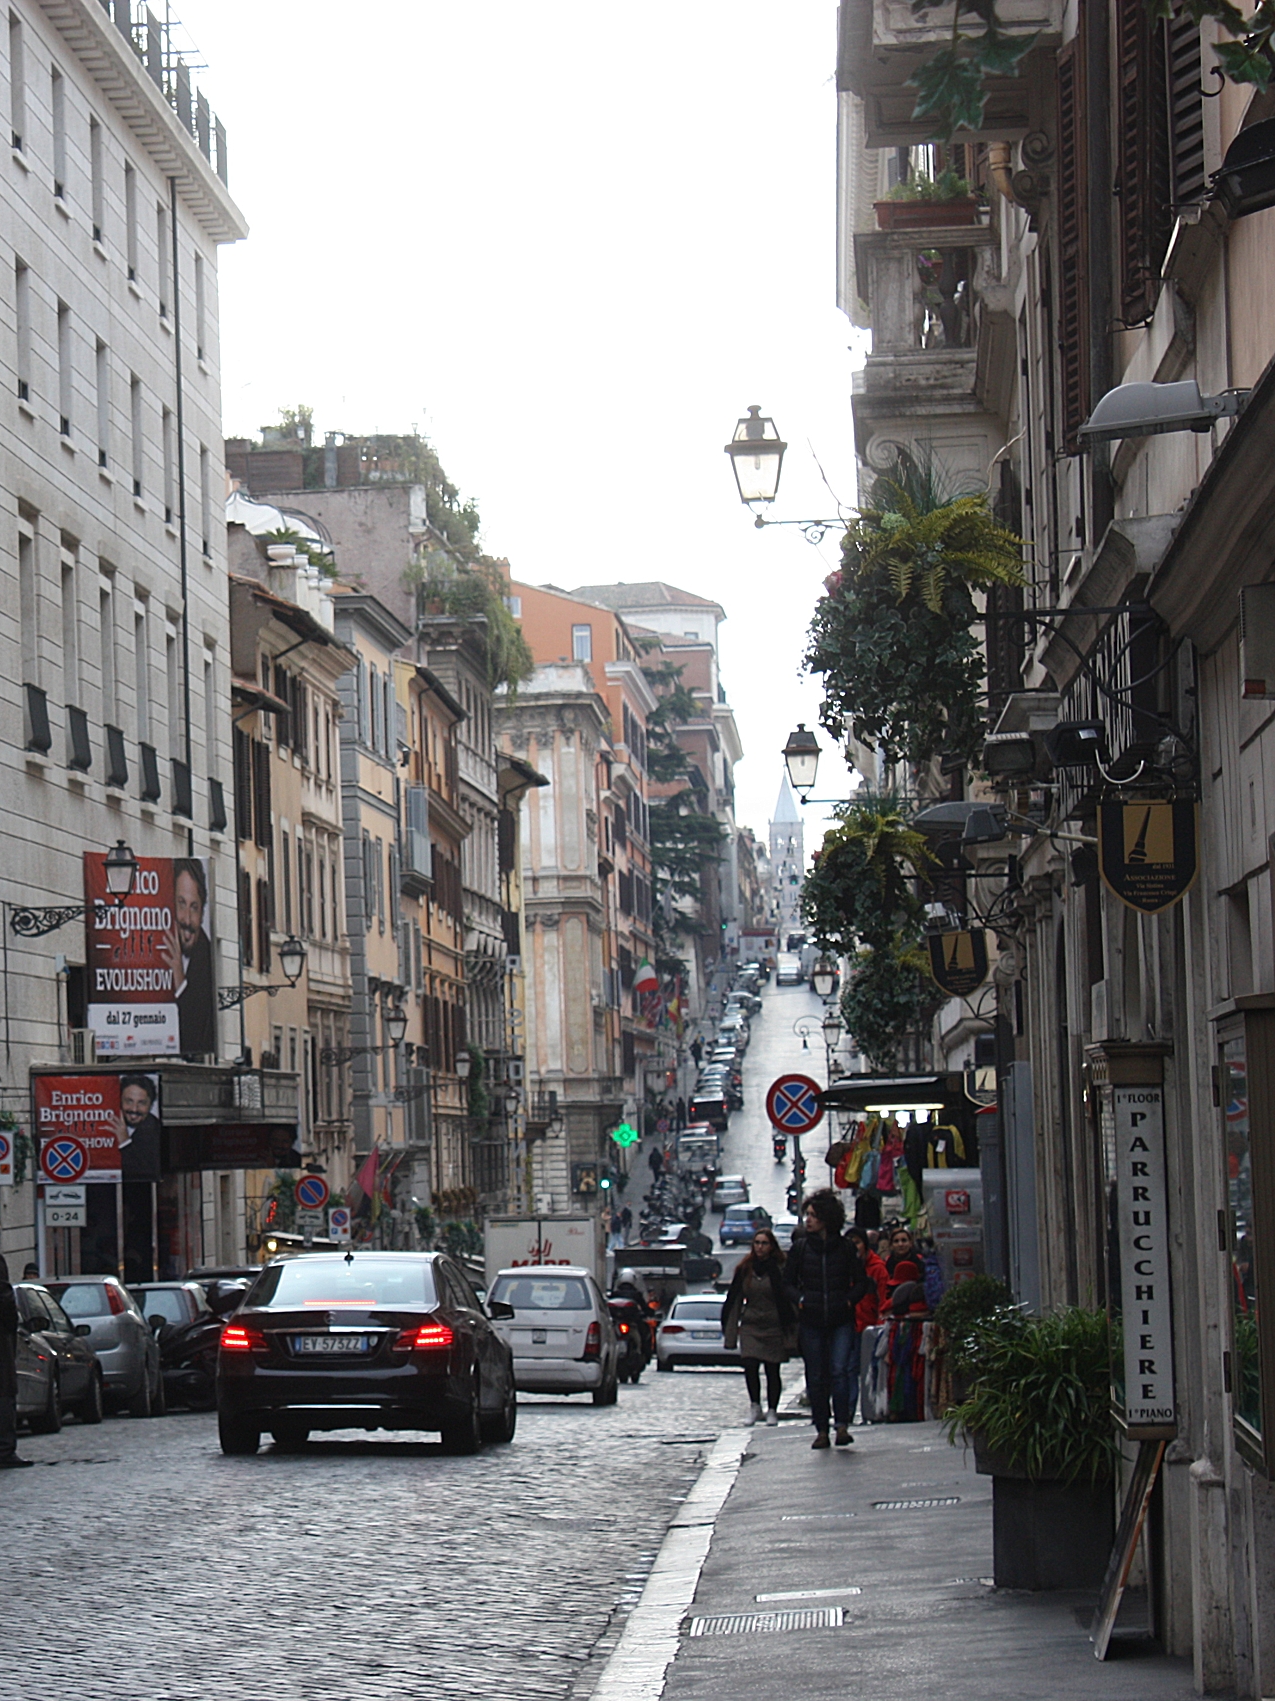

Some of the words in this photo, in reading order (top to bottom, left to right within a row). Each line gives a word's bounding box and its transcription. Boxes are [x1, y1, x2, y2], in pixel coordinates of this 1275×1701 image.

[94, 898, 171, 938] Brignano
[96, 968, 173, 991] EVOLUSHOW
[106, 1010, 120, 1025] dal
[122, 1011, 131, 1025] 27
[133, 1010, 167, 1028] gennaio
[51, 1090, 103, 1106] Enrico
[40, 1108, 115, 1125] Brignano
[52, 1212, 79, 1222] 0-24
[1129, 1111, 1158, 1400] PARRUCCHIERE
[304, 1337, 318, 1350] EV
